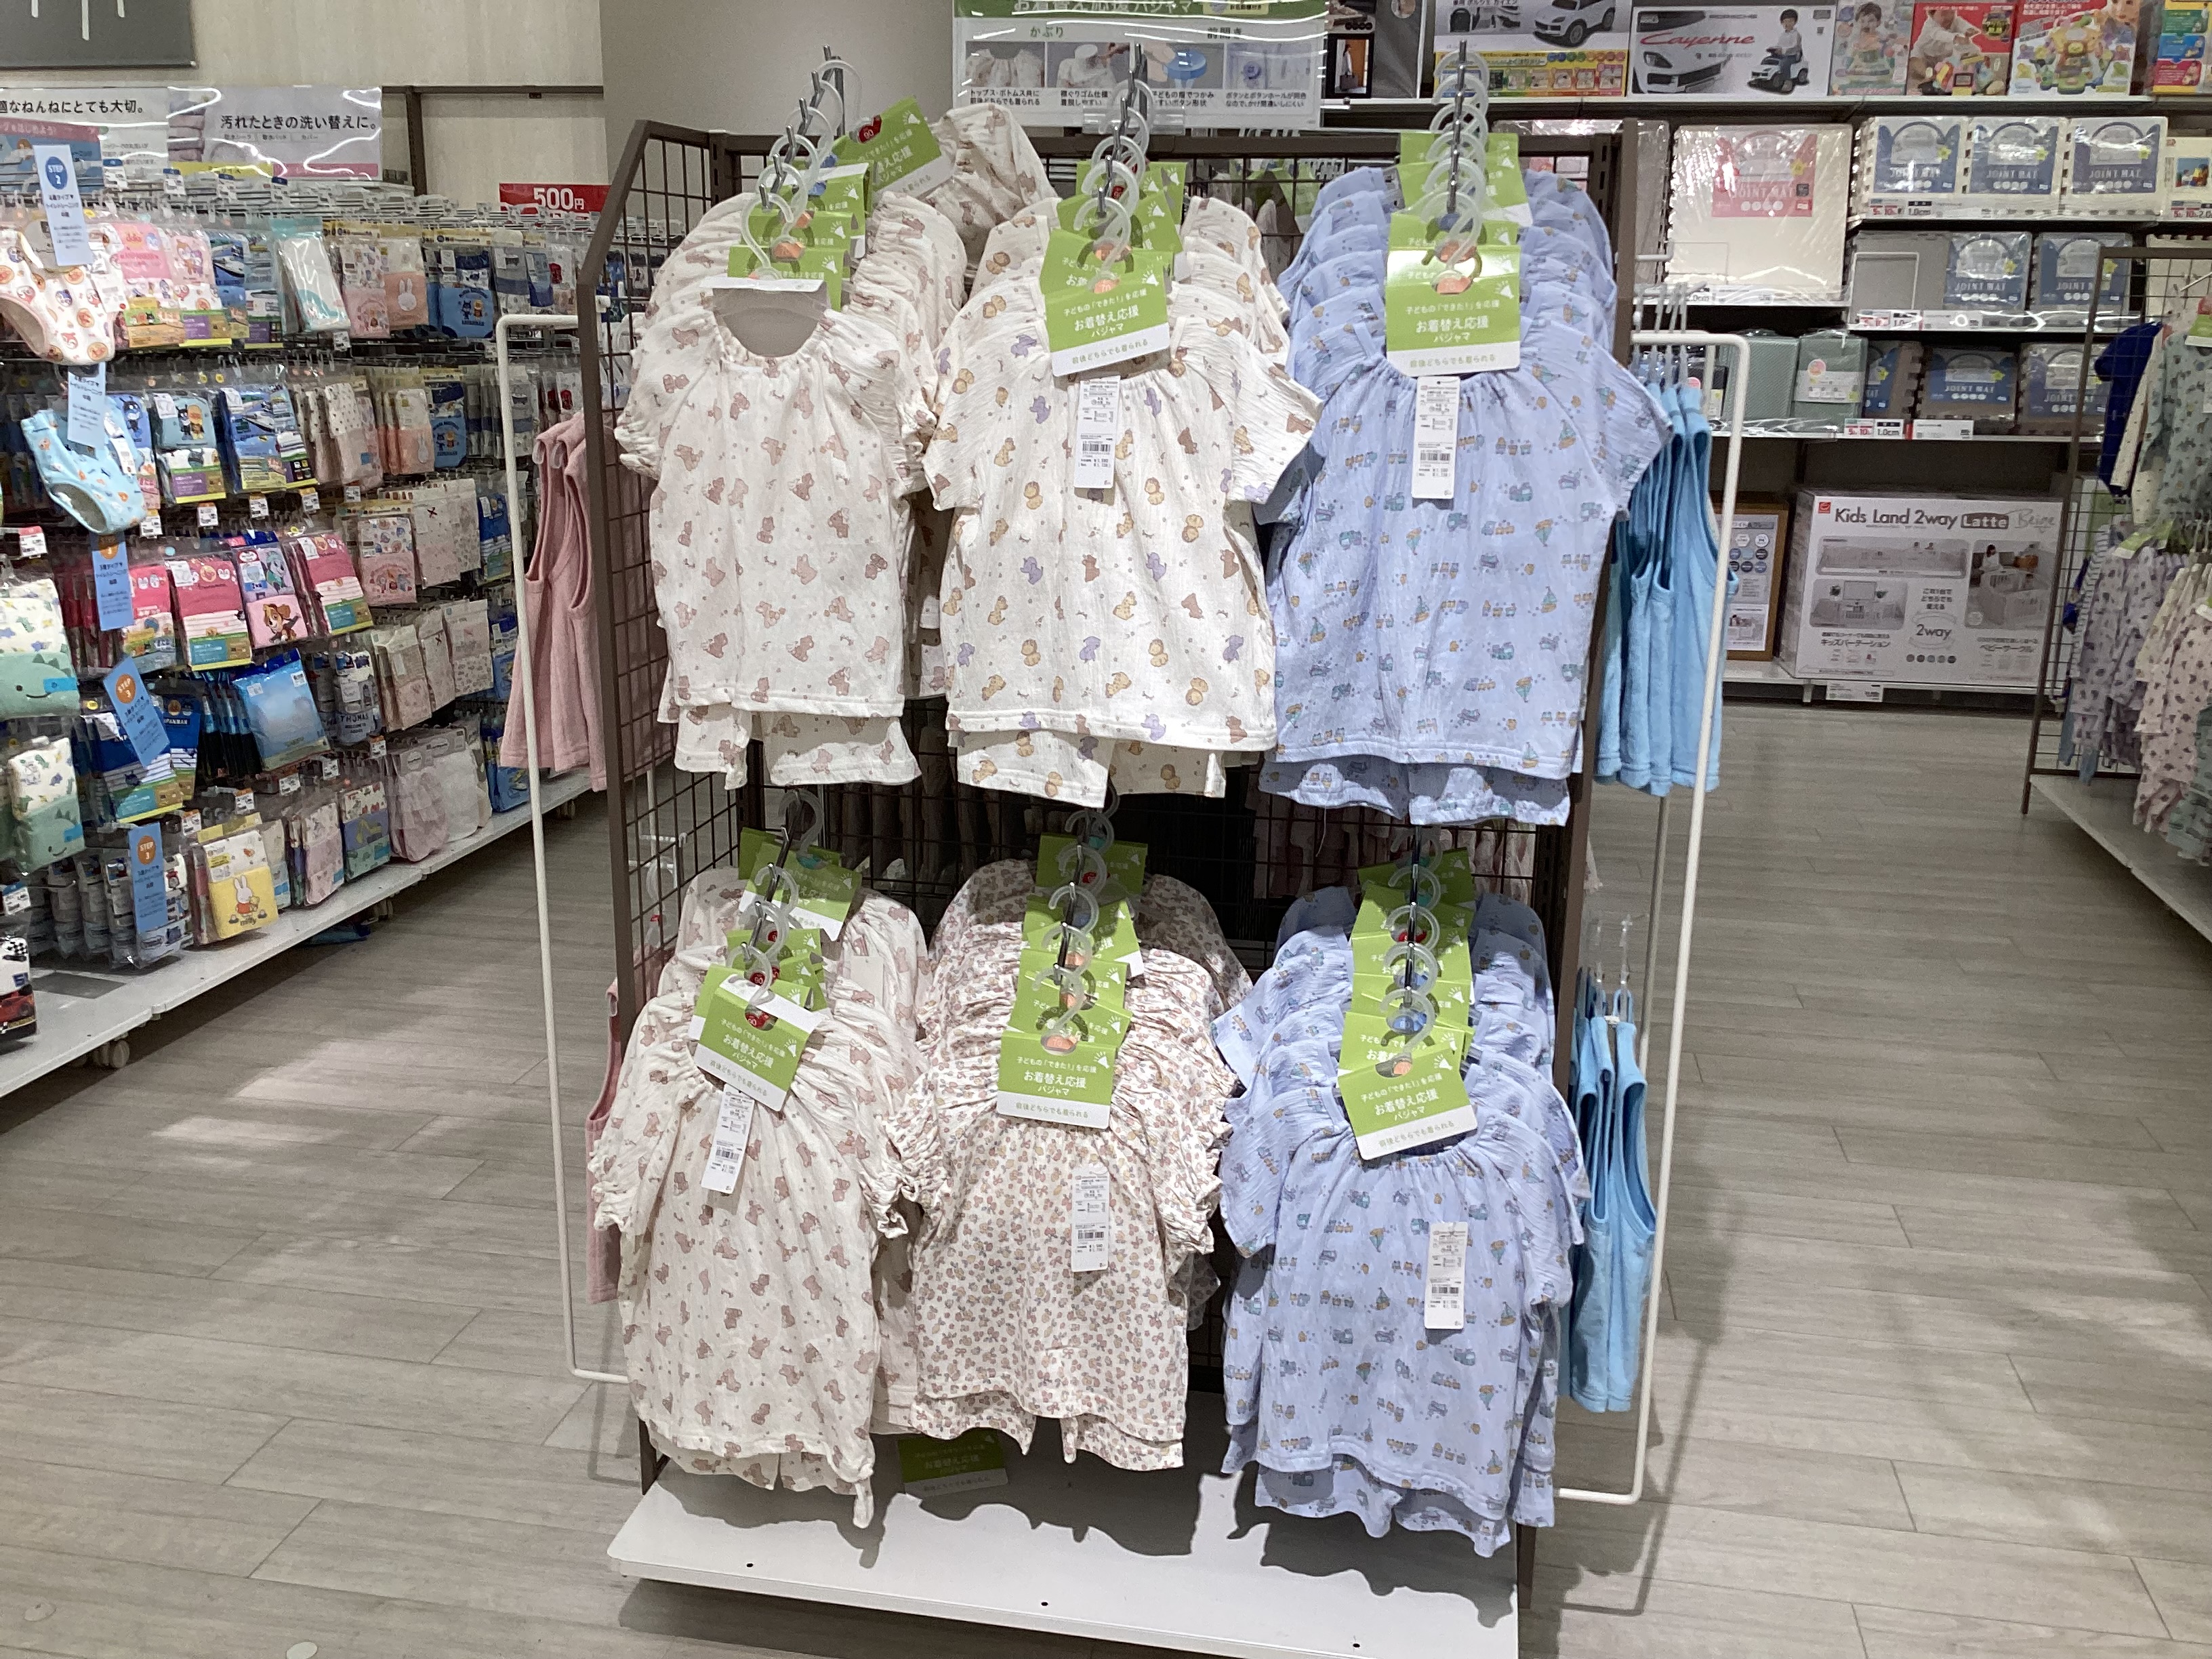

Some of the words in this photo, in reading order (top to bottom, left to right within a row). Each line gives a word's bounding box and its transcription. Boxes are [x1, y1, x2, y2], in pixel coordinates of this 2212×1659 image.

[1030, 26, 1064, 38] かぶり
[1640, 31, 1755, 49] Cayenne
[221, 115, 377, 130] 汚れたときの洗い替えに。
[863, 129, 875, 140] 80
[47, 165, 64, 173] STEP
[1987, 169, 2015, 178] JOINT
[2090, 169, 2118, 178] JOINT
[55, 176, 62, 184] 2
[533, 187, 585, 211] 500円
[1955, 282, 1984, 291] JOINT
[1987, 282, 2006, 291] MAT
[2057, 282, 2087, 291] JOINT
[1074, 304, 1140, 331] お着替え応援
[1091, 323, 1124, 337] パジャマ
[1416, 315, 1490, 333] お着替え応援
[1433, 332, 1471, 343] パジャマ
[1944, 385, 1973, 393] JOINT
[1975, 384, 1995, 394] MAT
[1877, 427, 1900, 436] 1.0cm
[1835, 508, 1866, 524] Kids
[1873, 508, 1910, 525] Land
[1914, 509, 1958, 530] 2way
[1963, 515, 2008, 529] Latte
[1916, 623, 1952, 640] 2way
[117, 678, 131, 693] STEP
[125, 689, 131, 698] 3
[140, 841, 154, 852] STEP
[747, 1019, 758, 1027] 80
[1023, 1070, 1086, 1089] お着替え応援
[1038, 1085, 1069, 1097] パジャマ
[1373, 1089, 1439, 1116] お着替え応援
[1393, 1106, 1426, 1122] パジャマ
